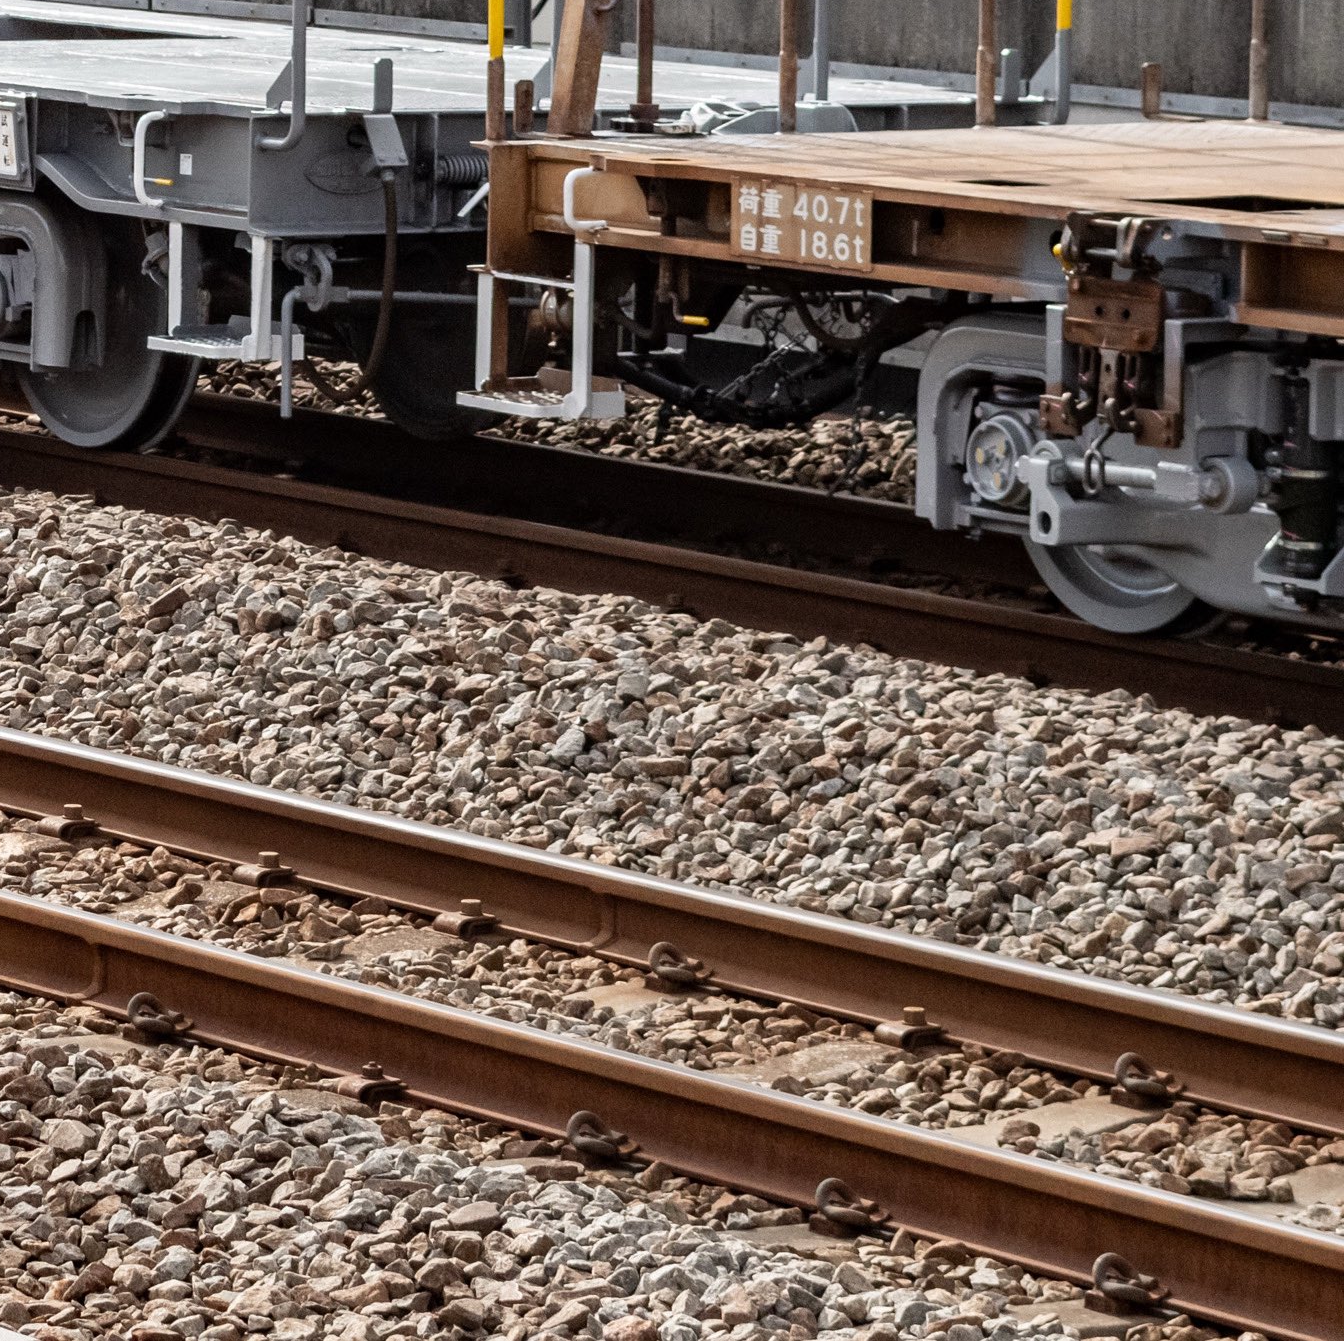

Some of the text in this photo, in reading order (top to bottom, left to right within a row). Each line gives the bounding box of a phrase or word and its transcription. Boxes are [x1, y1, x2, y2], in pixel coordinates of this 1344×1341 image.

[738, 185, 865, 228] 荷重 40.7t
[739, 222, 865, 264] 自重 18.6t
